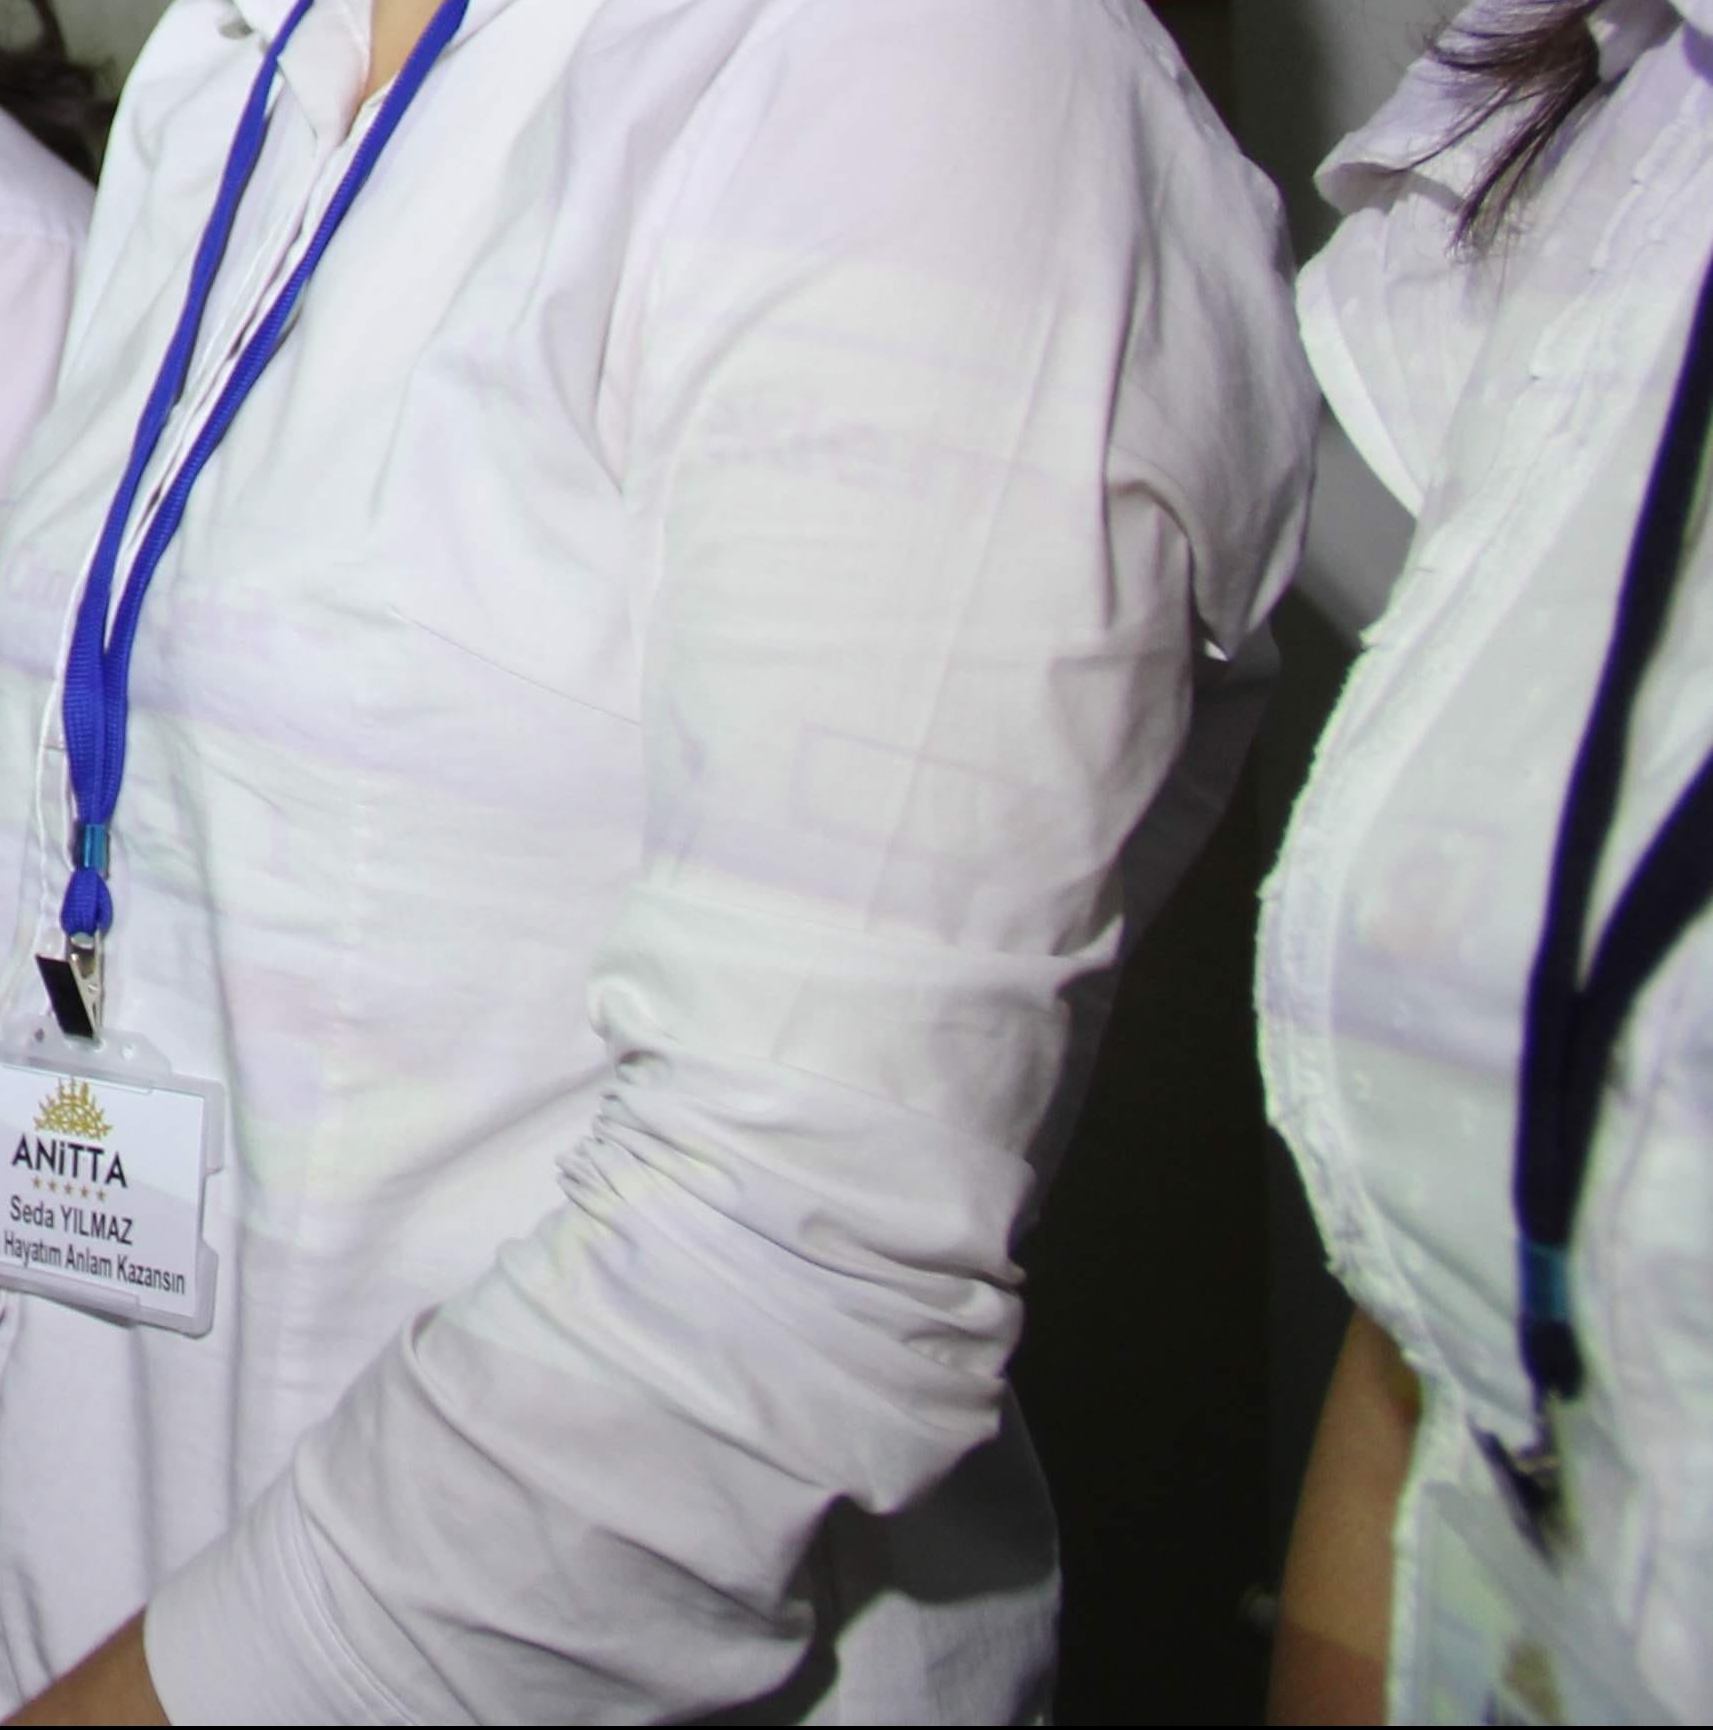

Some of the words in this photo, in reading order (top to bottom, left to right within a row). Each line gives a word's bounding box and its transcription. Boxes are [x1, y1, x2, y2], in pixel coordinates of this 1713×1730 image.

[10, 1194, 55, 1228] Seda
[60, 1204, 134, 1245] YILMAZ
[65, 1243, 113, 1278] Anlam
